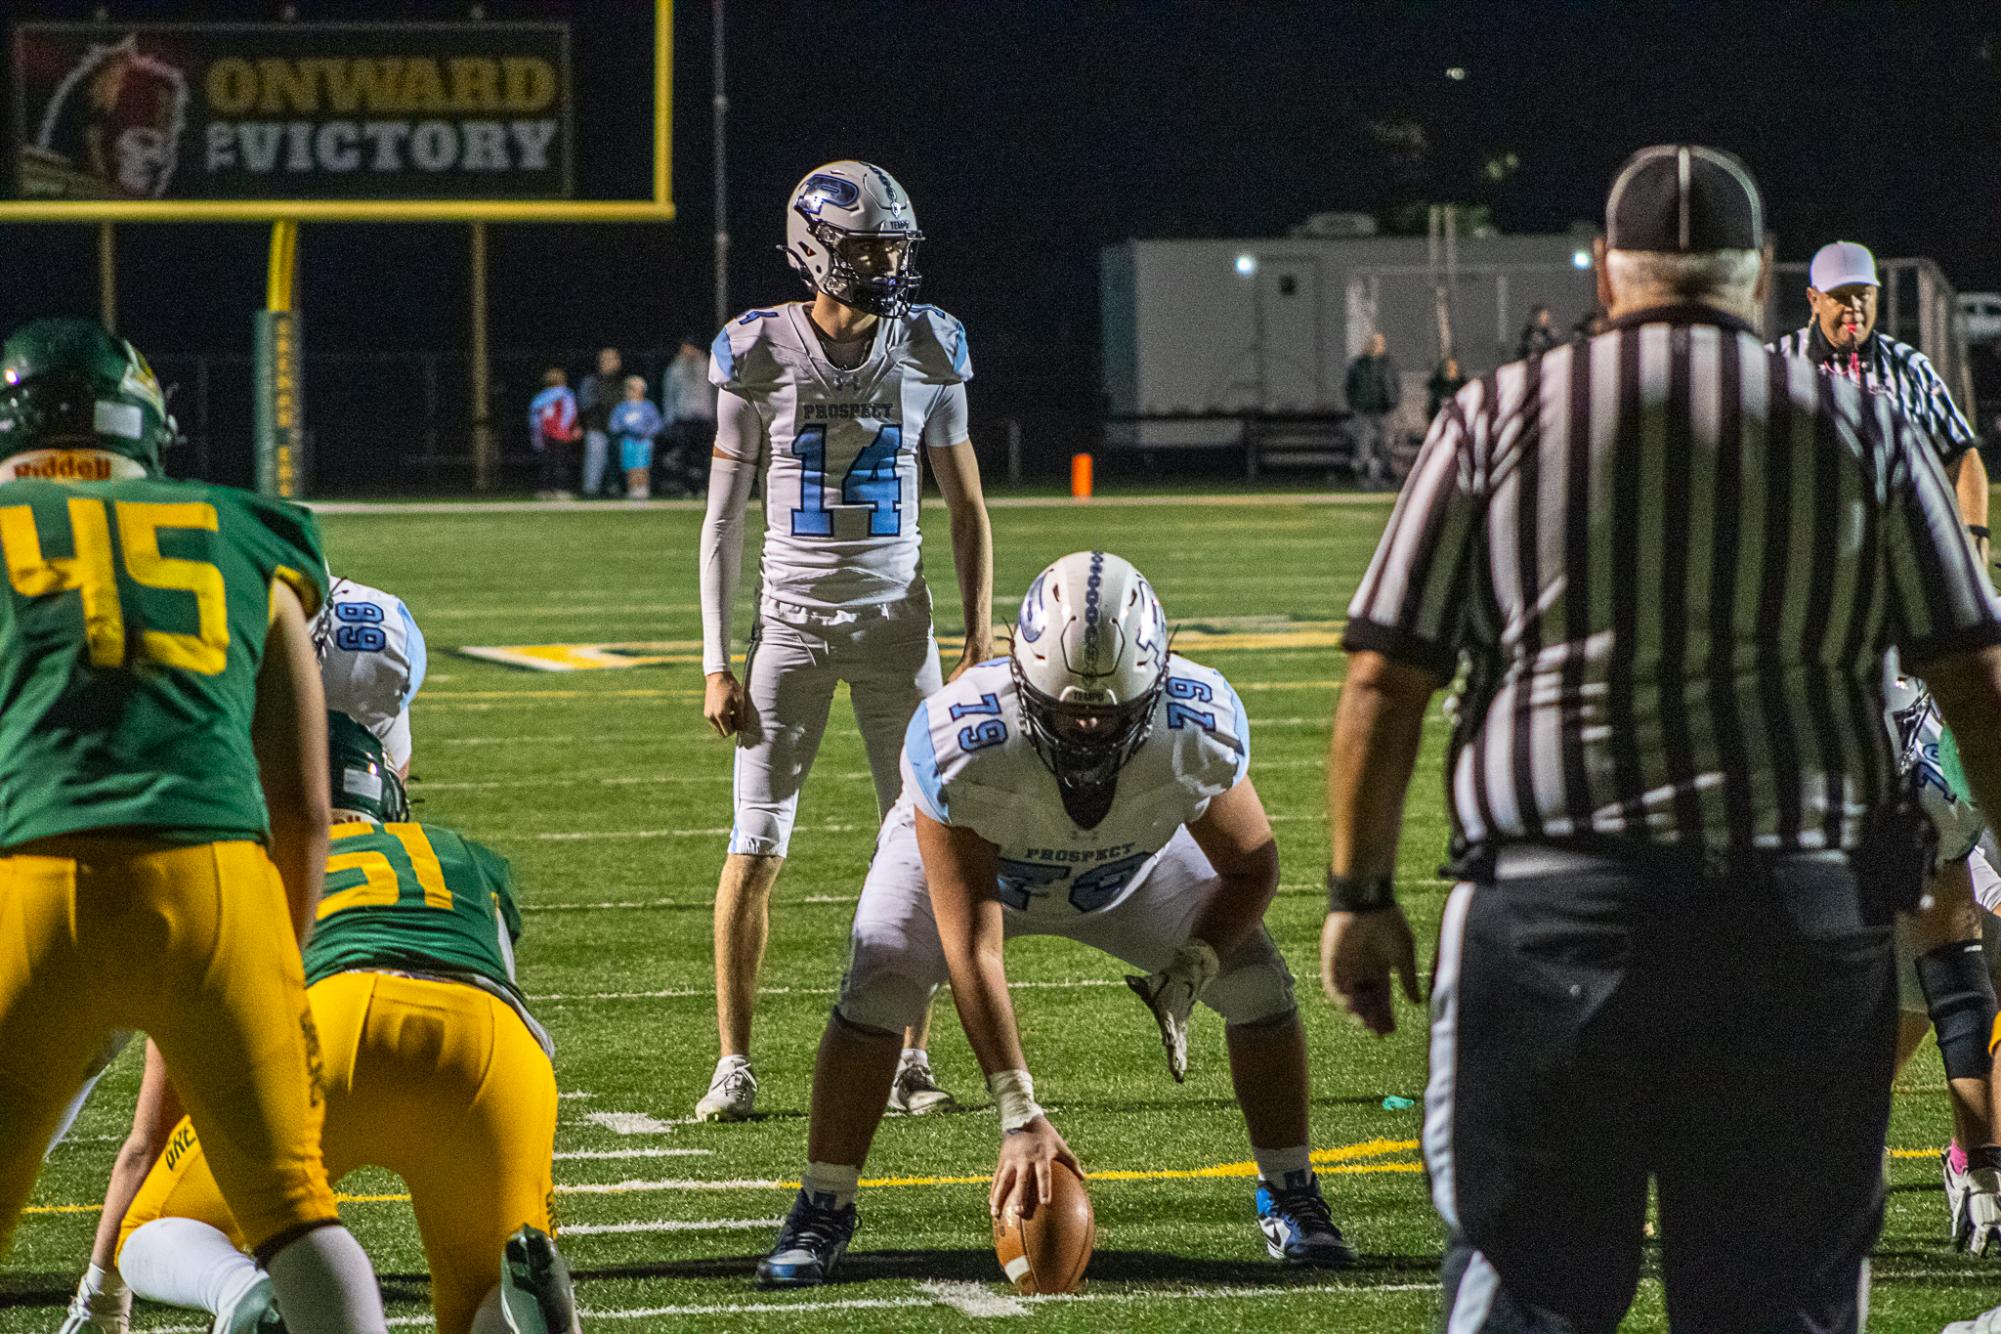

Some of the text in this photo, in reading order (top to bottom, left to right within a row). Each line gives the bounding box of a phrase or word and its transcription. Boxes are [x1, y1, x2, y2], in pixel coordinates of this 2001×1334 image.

[207, 57, 556, 113] ONWARD
[239, 120, 557, 172] VICTORY
[803, 402, 894, 419] PROSPECT
[791, 423, 902, 536] 14
[0, 497, 229, 676] 45
[335, 602, 386, 652] 68
[949, 692, 1008, 752] 79
[1166, 676, 1216, 732] 79
[315, 821, 454, 920] 51
[1025, 842, 1135, 863] PROSPECT
